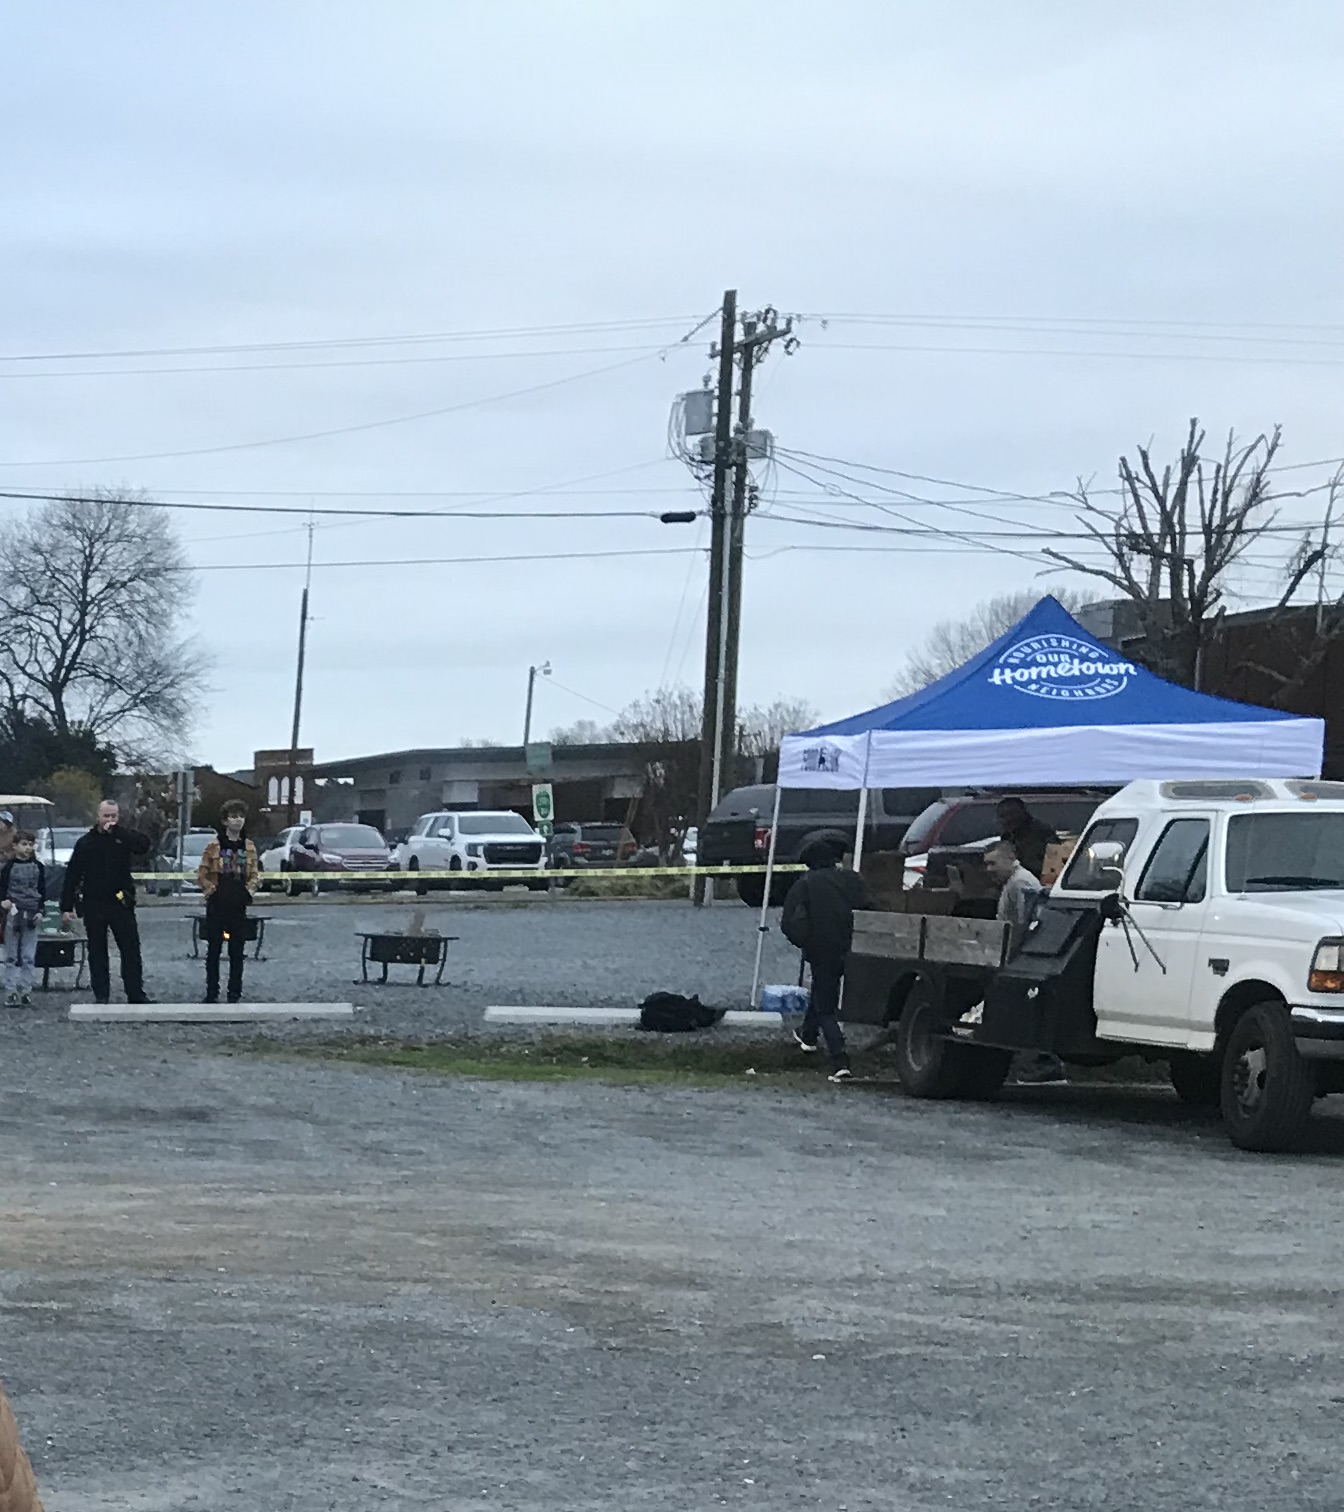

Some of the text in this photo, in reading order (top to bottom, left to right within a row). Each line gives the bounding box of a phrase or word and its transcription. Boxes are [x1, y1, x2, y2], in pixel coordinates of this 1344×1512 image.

[1007, 637, 1100, 664] NOURISHING
[1035, 653, 1071, 663] OUR
[987, 658, 1138, 686] Hometown
